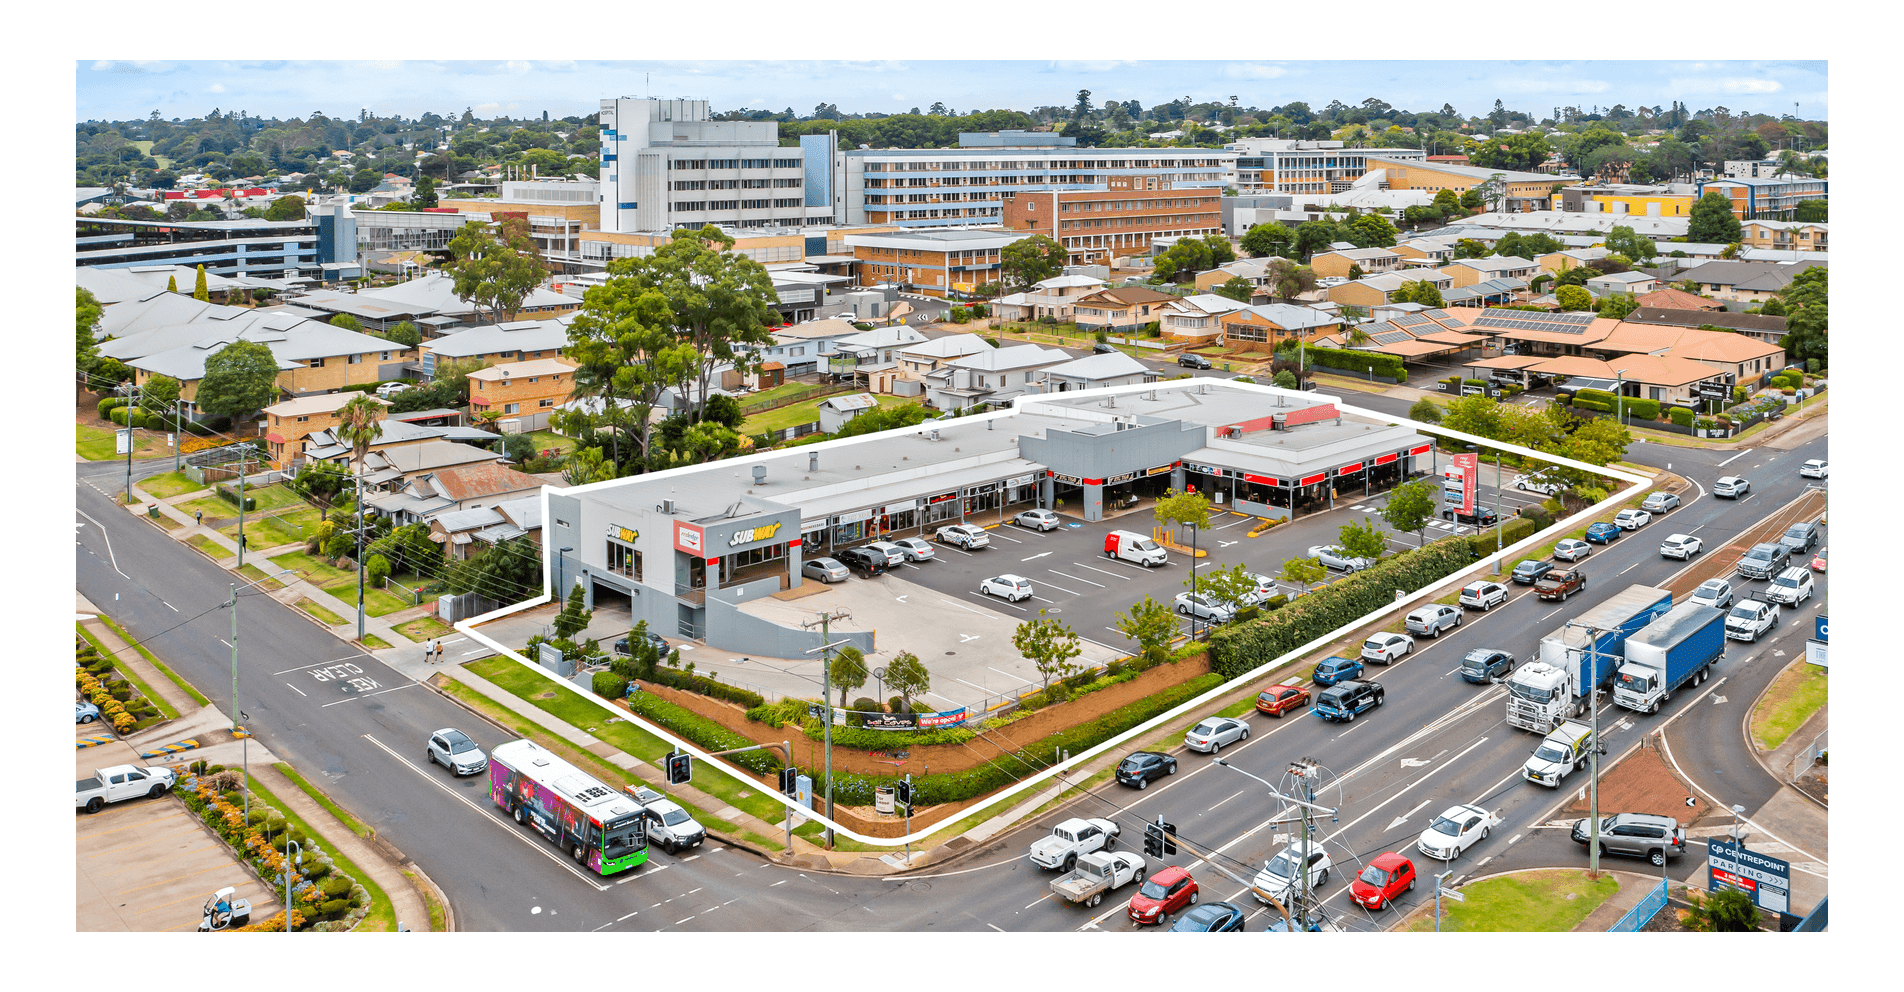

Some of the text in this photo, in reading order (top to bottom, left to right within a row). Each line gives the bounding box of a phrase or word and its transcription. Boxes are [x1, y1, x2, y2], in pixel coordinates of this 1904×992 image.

[606, 523, 639, 544] SUBWAY
[728, 521, 781, 548] SUBWAY
[307, 663, 363, 682] CLEAR
[920, 716, 938, 725] We're
[1725, 848, 1786, 872] CENTREPOINT
